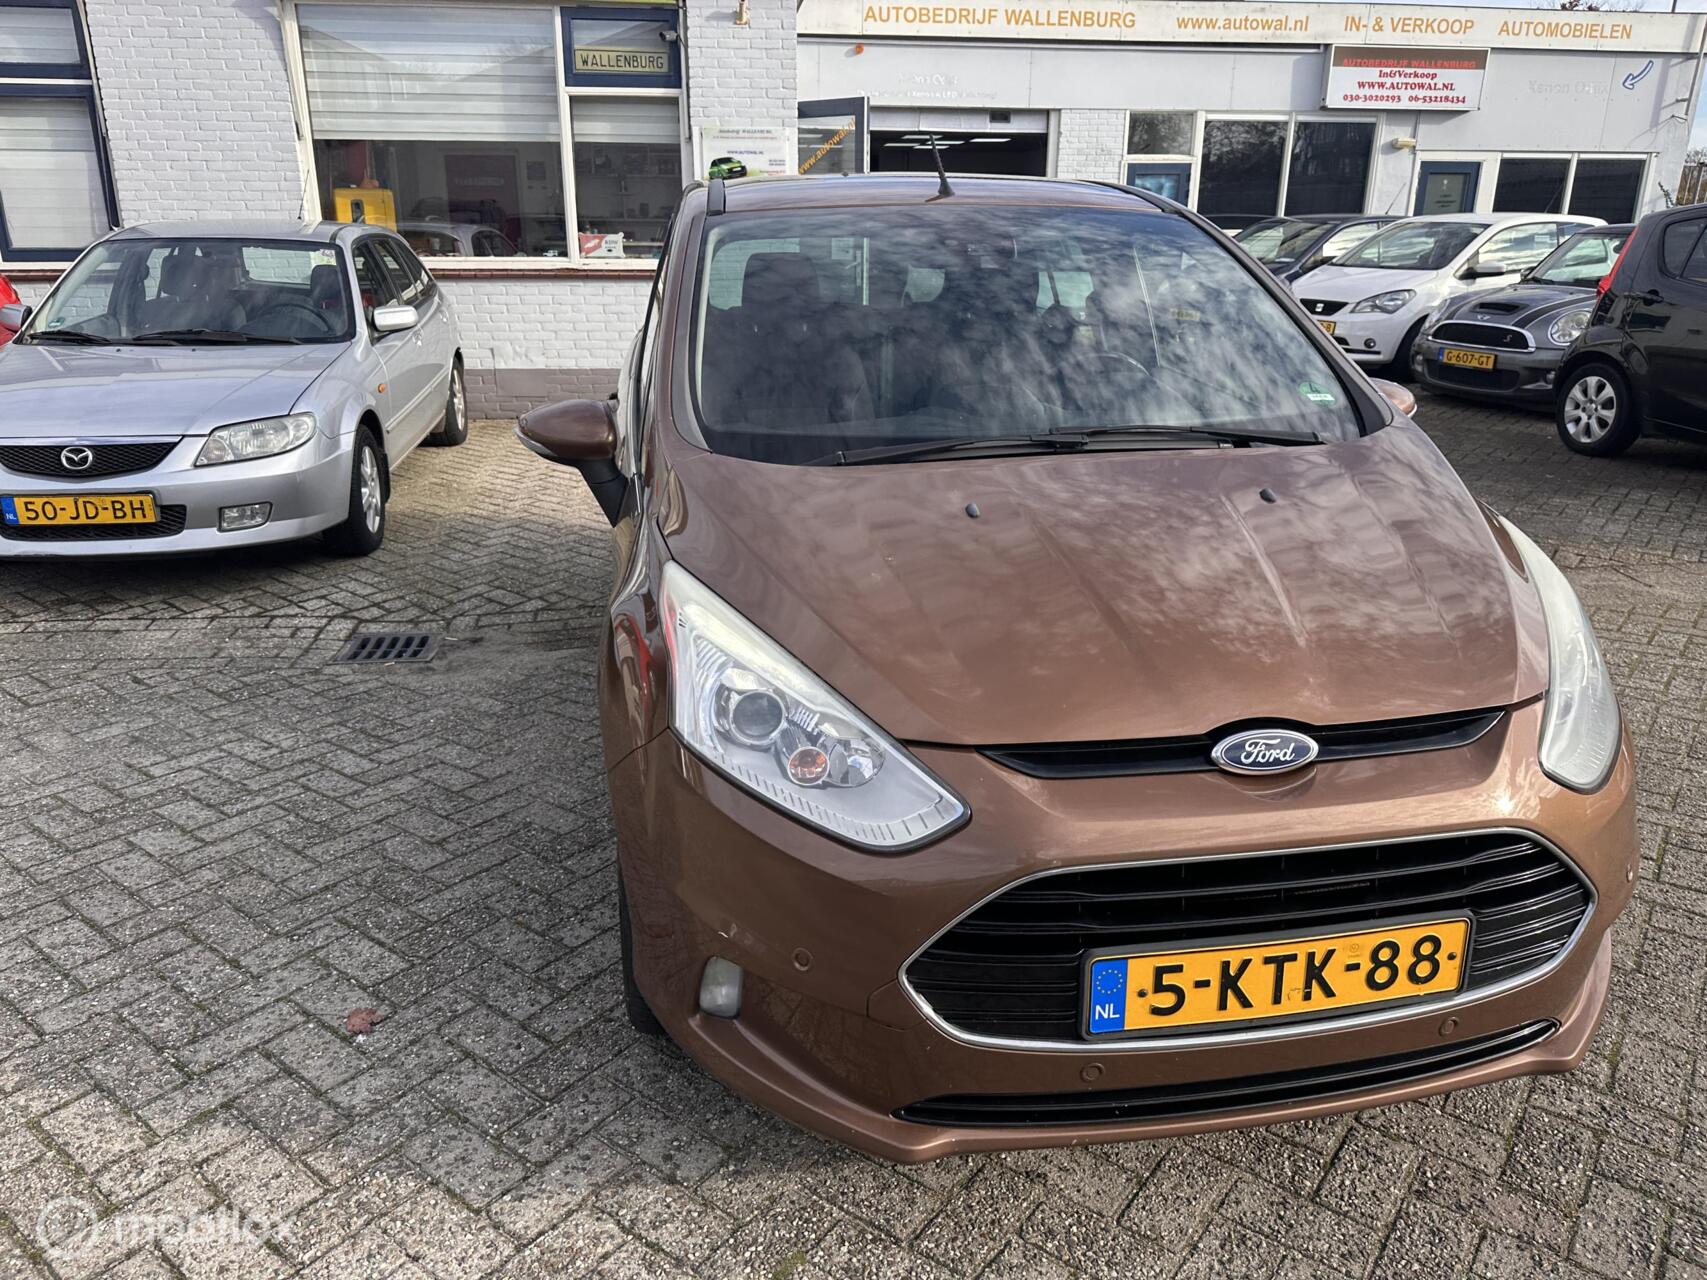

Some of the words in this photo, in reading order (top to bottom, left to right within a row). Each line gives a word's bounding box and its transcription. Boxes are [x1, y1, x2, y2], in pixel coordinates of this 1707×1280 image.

[864, 5, 998, 25] AUTOBEDRIJF
[1004, 8, 1136, 29] WALLENBURG
[1176, 15, 1310, 32] www.autowal.nl
[1343, 15, 1367, 32] IN-
[1372, 16, 1385, 33] &
[1390, 17, 1475, 36] VERKOOP
[1498, 20, 1633, 39] AUTOMOBIELEN
[580, 53, 664, 69] WALLENBURG
[1343, 58, 1409, 68] AUTOBEDRIJF
[1411, 59, 1477, 69] WALLENBURG
[1378, 69, 1438, 81] In&Verkoop
[1357, 81, 1456, 92] WWW.AUTOWAL.NL
[1343, 94, 1402, 103] 030-3020293
[1446, 350, 1492, 367] G-607-GT
[23, 499, 148, 521] 50-JD-BH
[1241, 738, 1296, 765] Ford
[1094, 1003, 1121, 1021] NL
[1149, 933, 1443, 1018] 5-KTK-88
